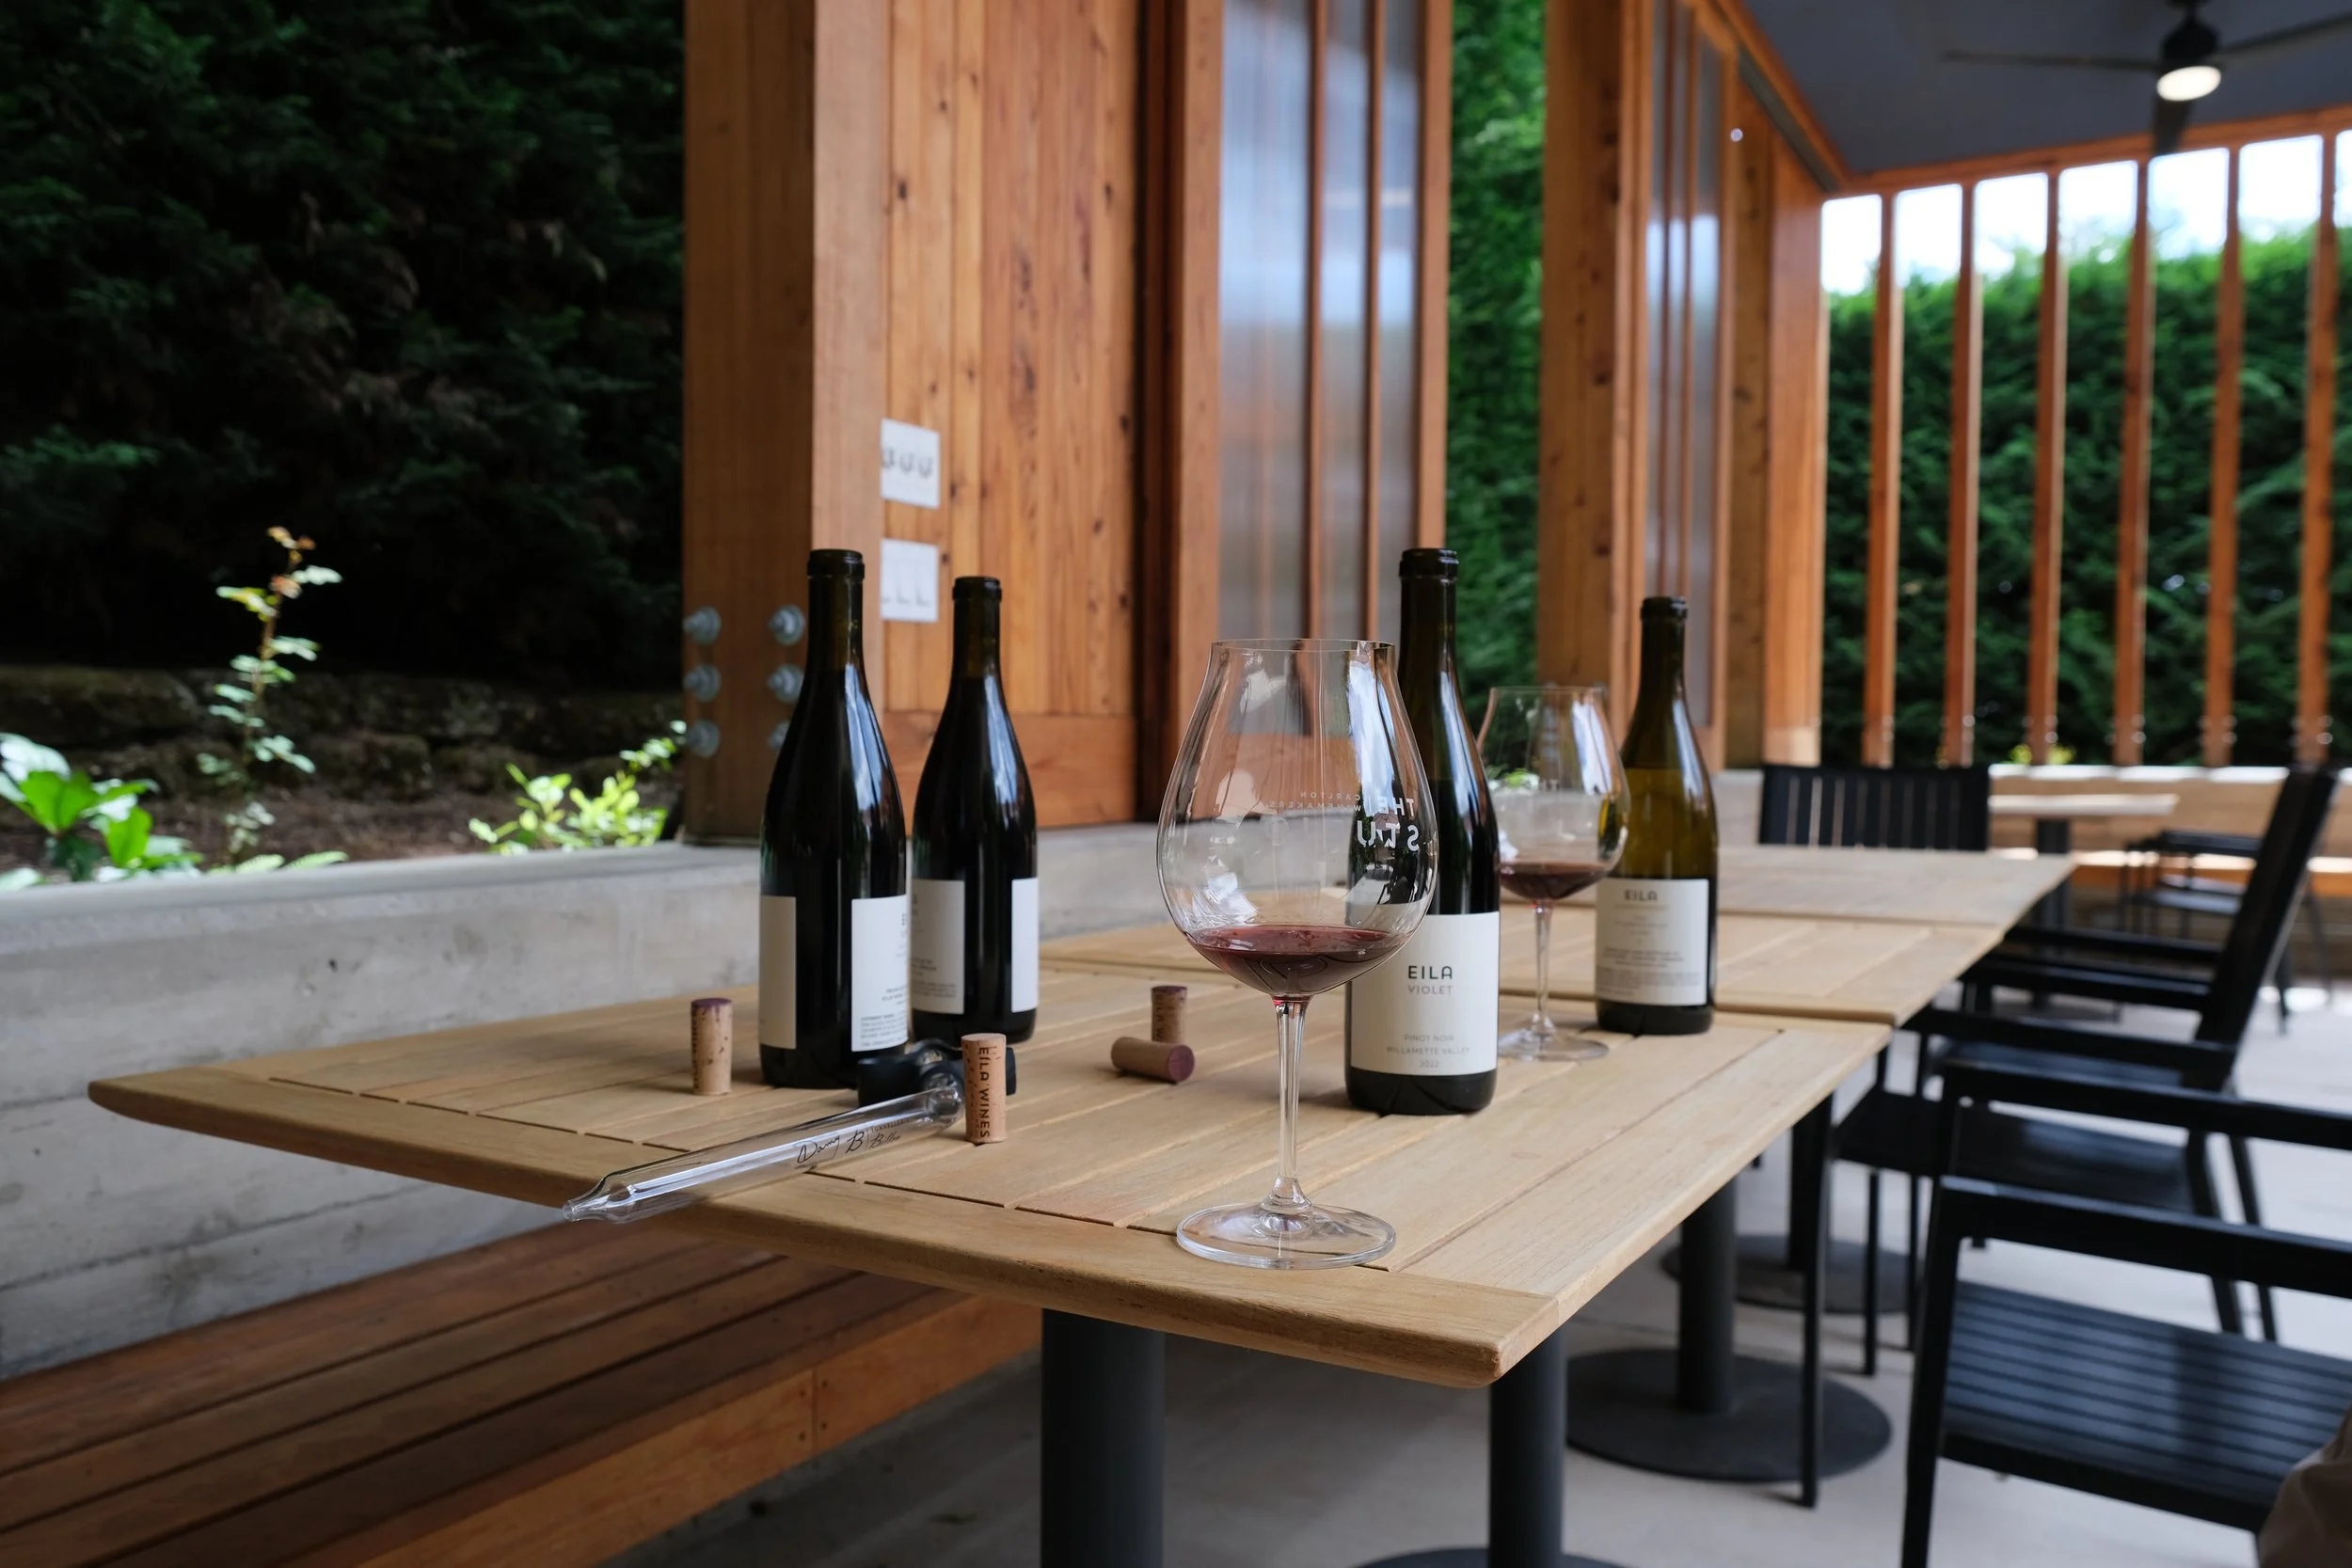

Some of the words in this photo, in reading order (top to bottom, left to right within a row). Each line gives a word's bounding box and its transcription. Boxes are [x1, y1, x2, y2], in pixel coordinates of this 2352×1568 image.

[1407, 965, 1453, 980] EILA
[1407, 984, 1454, 996] VIOLET
[1404, 1034, 1431, 1043] PINOT
[1433, 1035, 1454, 1043] NOIR
[1386, 1045, 1438, 1056] WILLAMETTE
[1441, 1046, 1470, 1056] VALLEY
[978, 1046, 990, 1082] EILA
[978, 1088, 991, 1139] WINES
